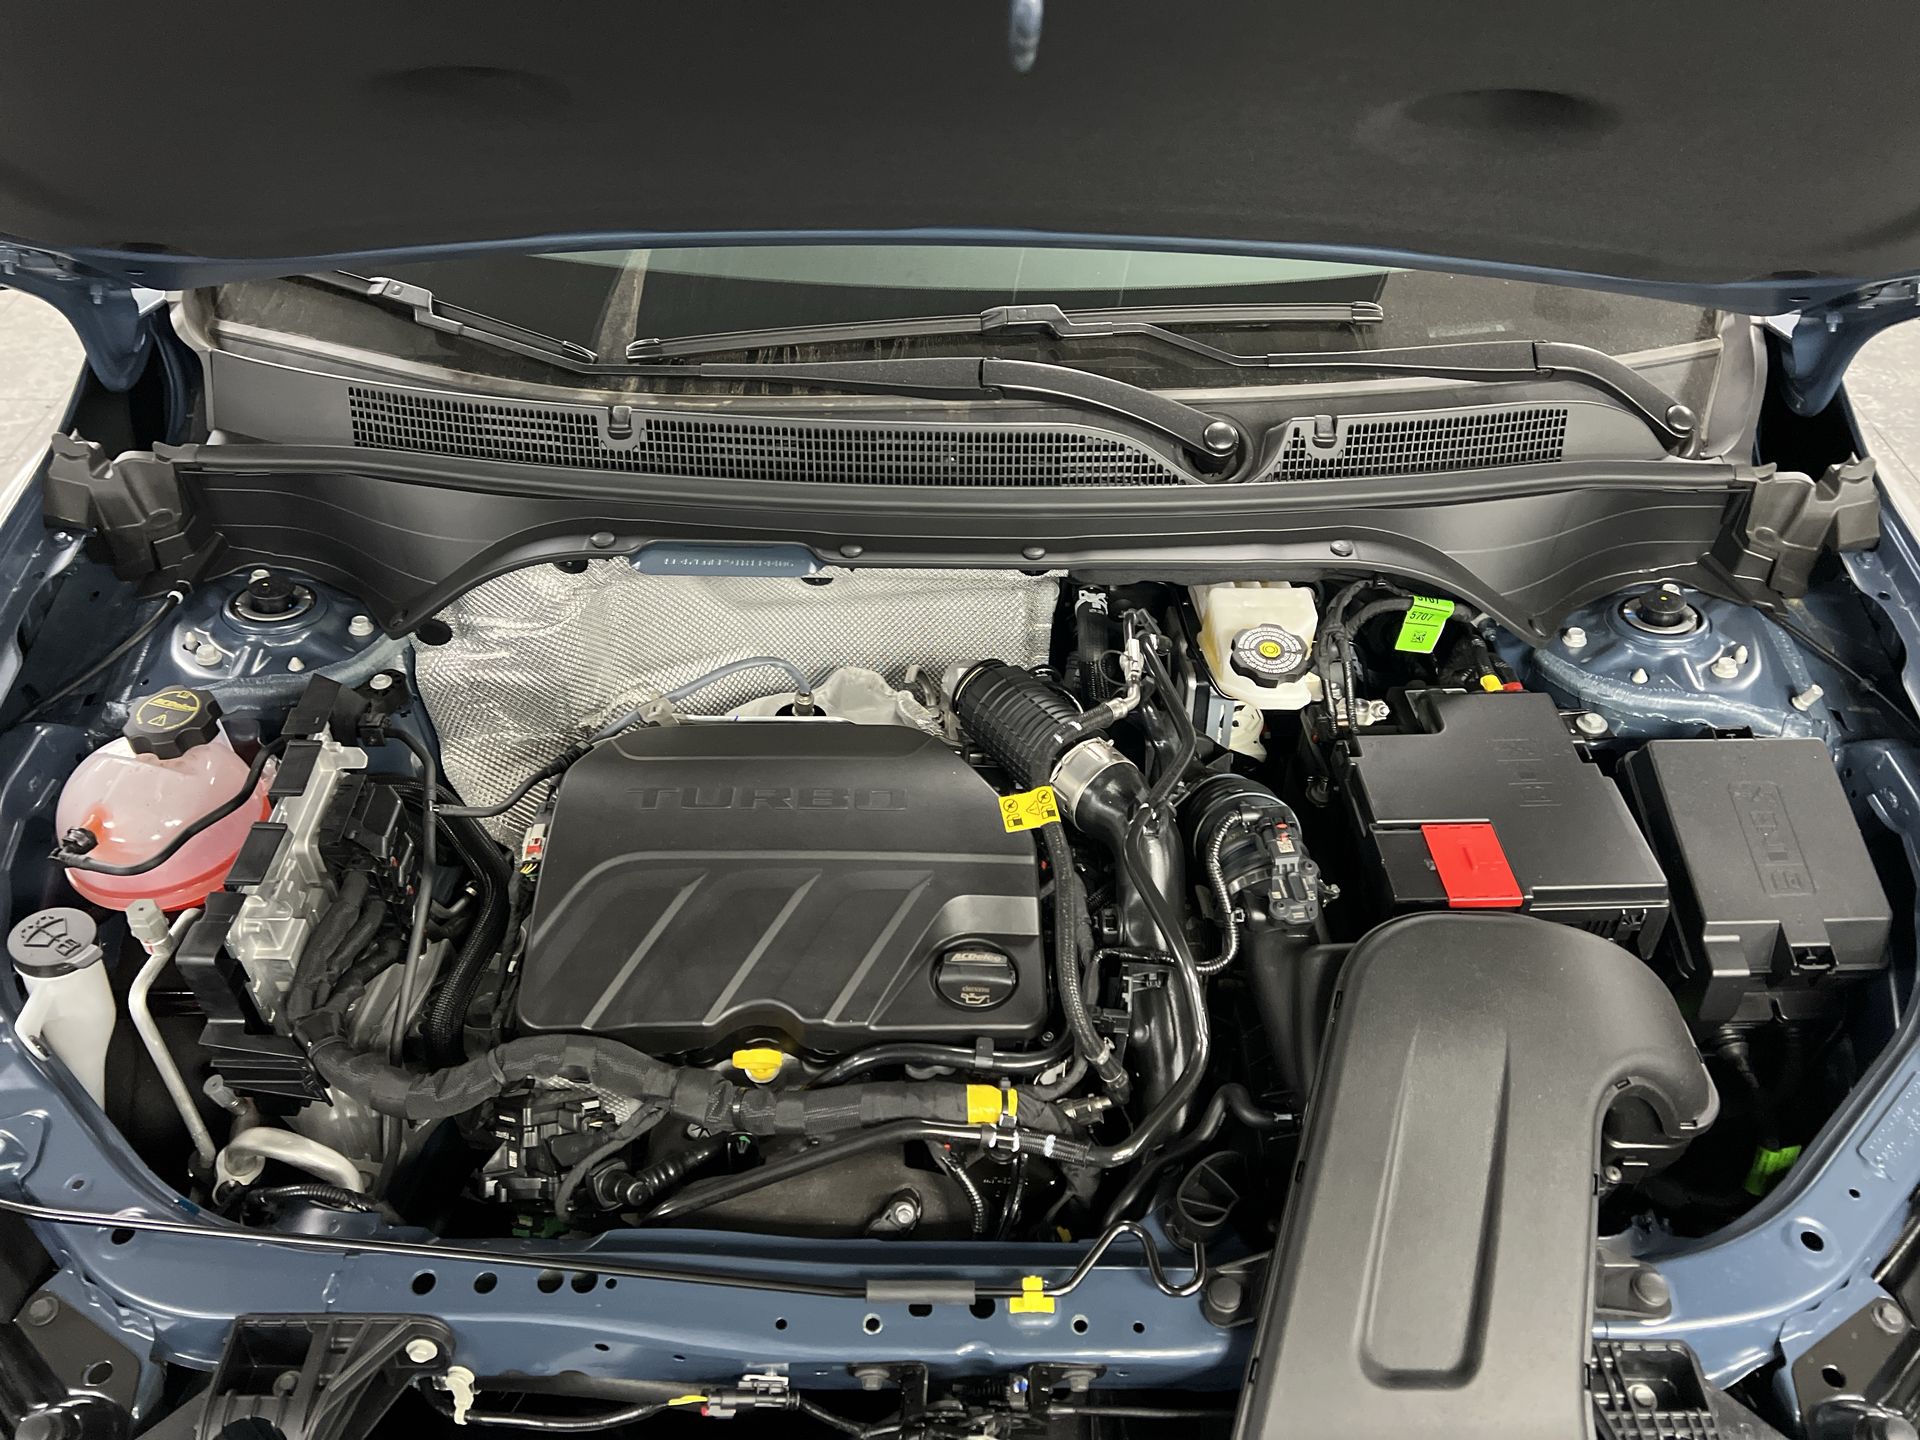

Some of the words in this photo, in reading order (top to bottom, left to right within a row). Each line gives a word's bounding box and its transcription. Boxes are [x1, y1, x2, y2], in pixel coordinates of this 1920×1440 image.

[1410, 611, 1434, 621] 5707
[626, 786, 908, 811] TURBO
[950, 952, 1002, 963] ACDelco
